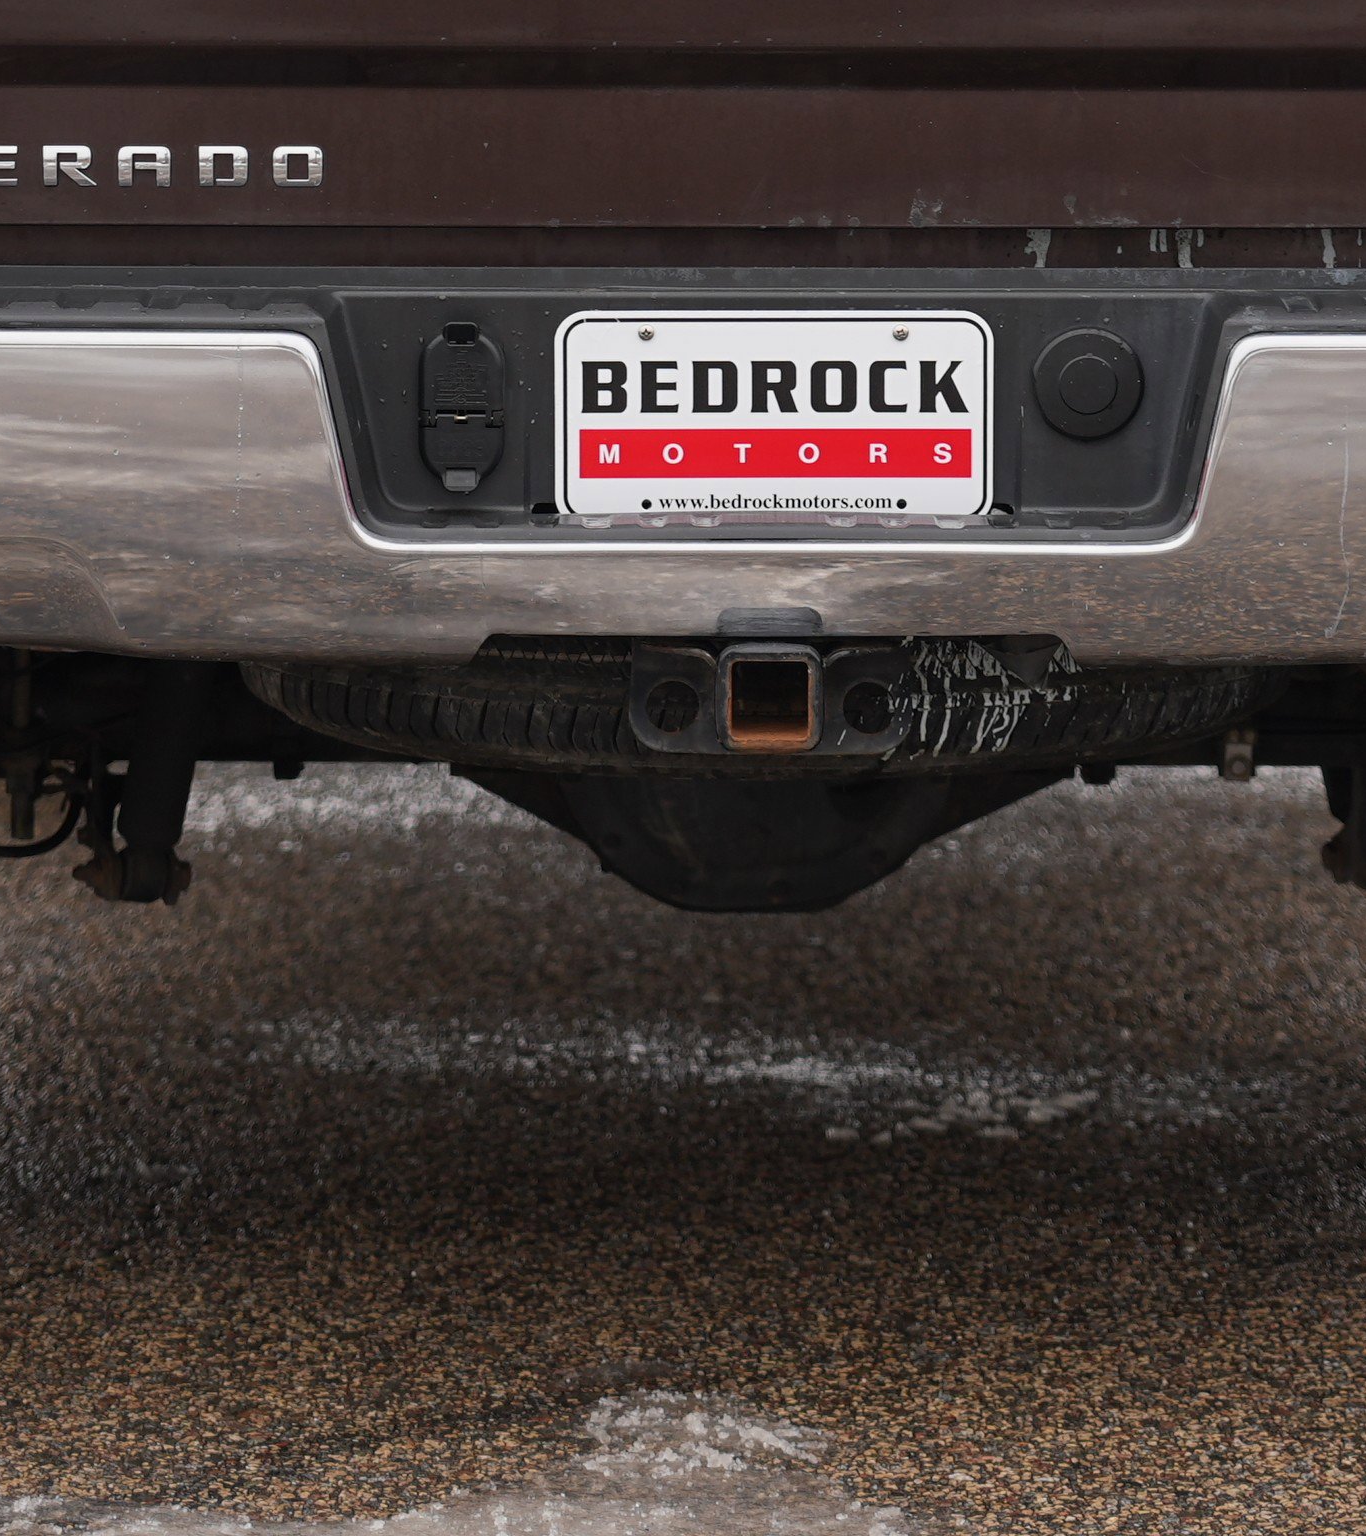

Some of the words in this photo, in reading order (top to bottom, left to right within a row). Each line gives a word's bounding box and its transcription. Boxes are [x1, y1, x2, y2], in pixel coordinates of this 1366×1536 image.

[581, 360, 969, 413] BEDROCK
[598, 442, 953, 464] MOTORS
[659, 494, 893, 510] www.bedrockmotors.com
